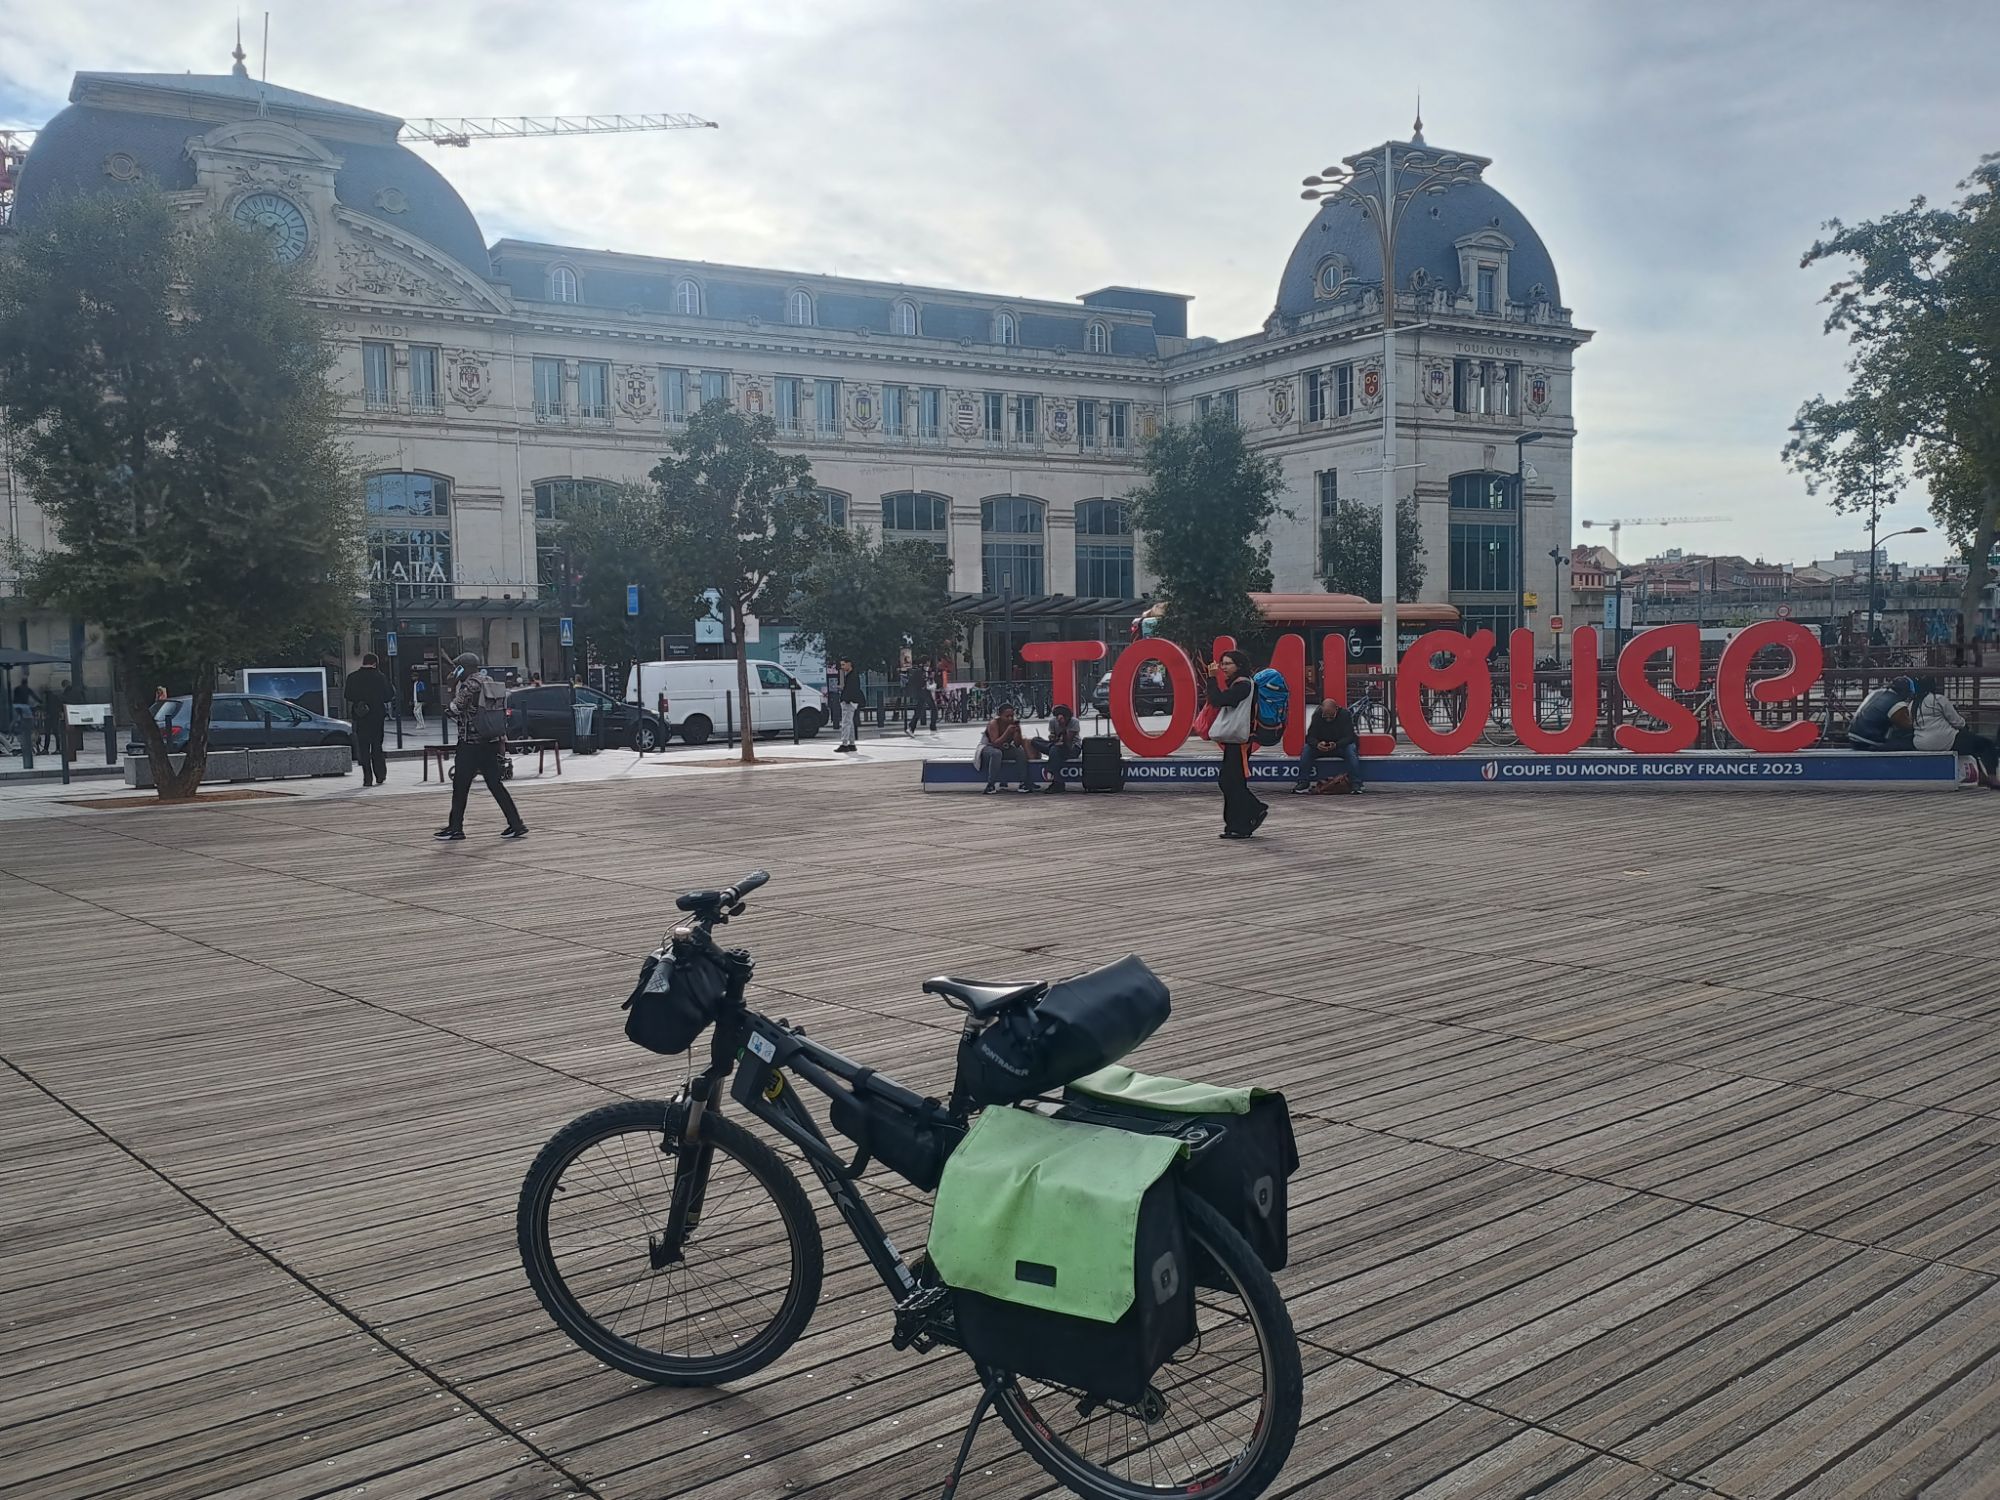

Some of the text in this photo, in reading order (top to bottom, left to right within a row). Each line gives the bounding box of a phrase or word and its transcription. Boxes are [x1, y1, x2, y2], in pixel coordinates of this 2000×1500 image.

[369, 323, 409, 338] MIDI
[1455, 343, 1520, 358] TOULOUSE
[1127, 767, 1177, 777] MONDE
[1180, 766, 1221, 777] RUGBY
[1282, 766, 1318, 777] 203
[1502, 762, 1804, 777] COUPE DU MONDE RUGBY FRANCE 2023
[981, 1043, 1030, 1077] BONTRAGER
